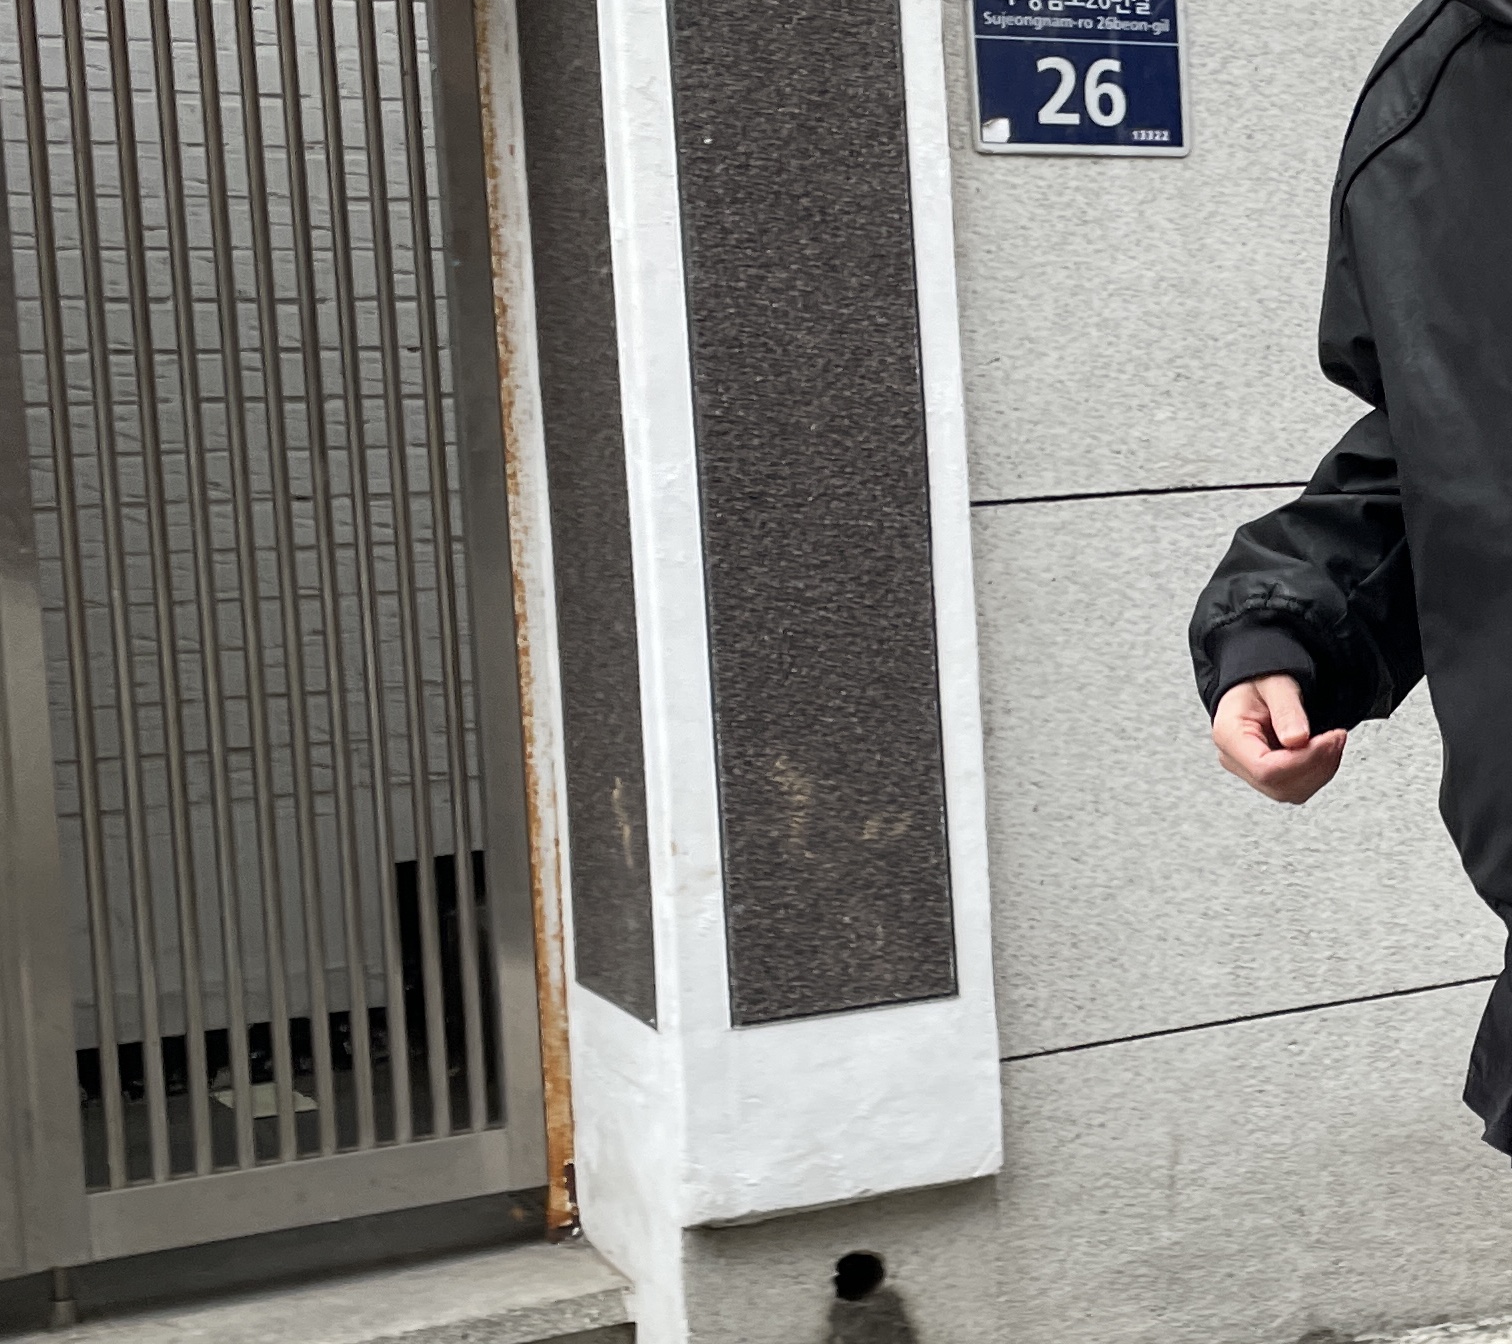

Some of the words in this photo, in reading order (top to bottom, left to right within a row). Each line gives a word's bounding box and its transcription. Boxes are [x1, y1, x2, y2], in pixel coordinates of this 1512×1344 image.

[983, 11, 1092, 30] Sujeongnam-ro
[1097, 17, 1170, 35] 26beon-gil
[1037, 56, 1126, 127] 26
